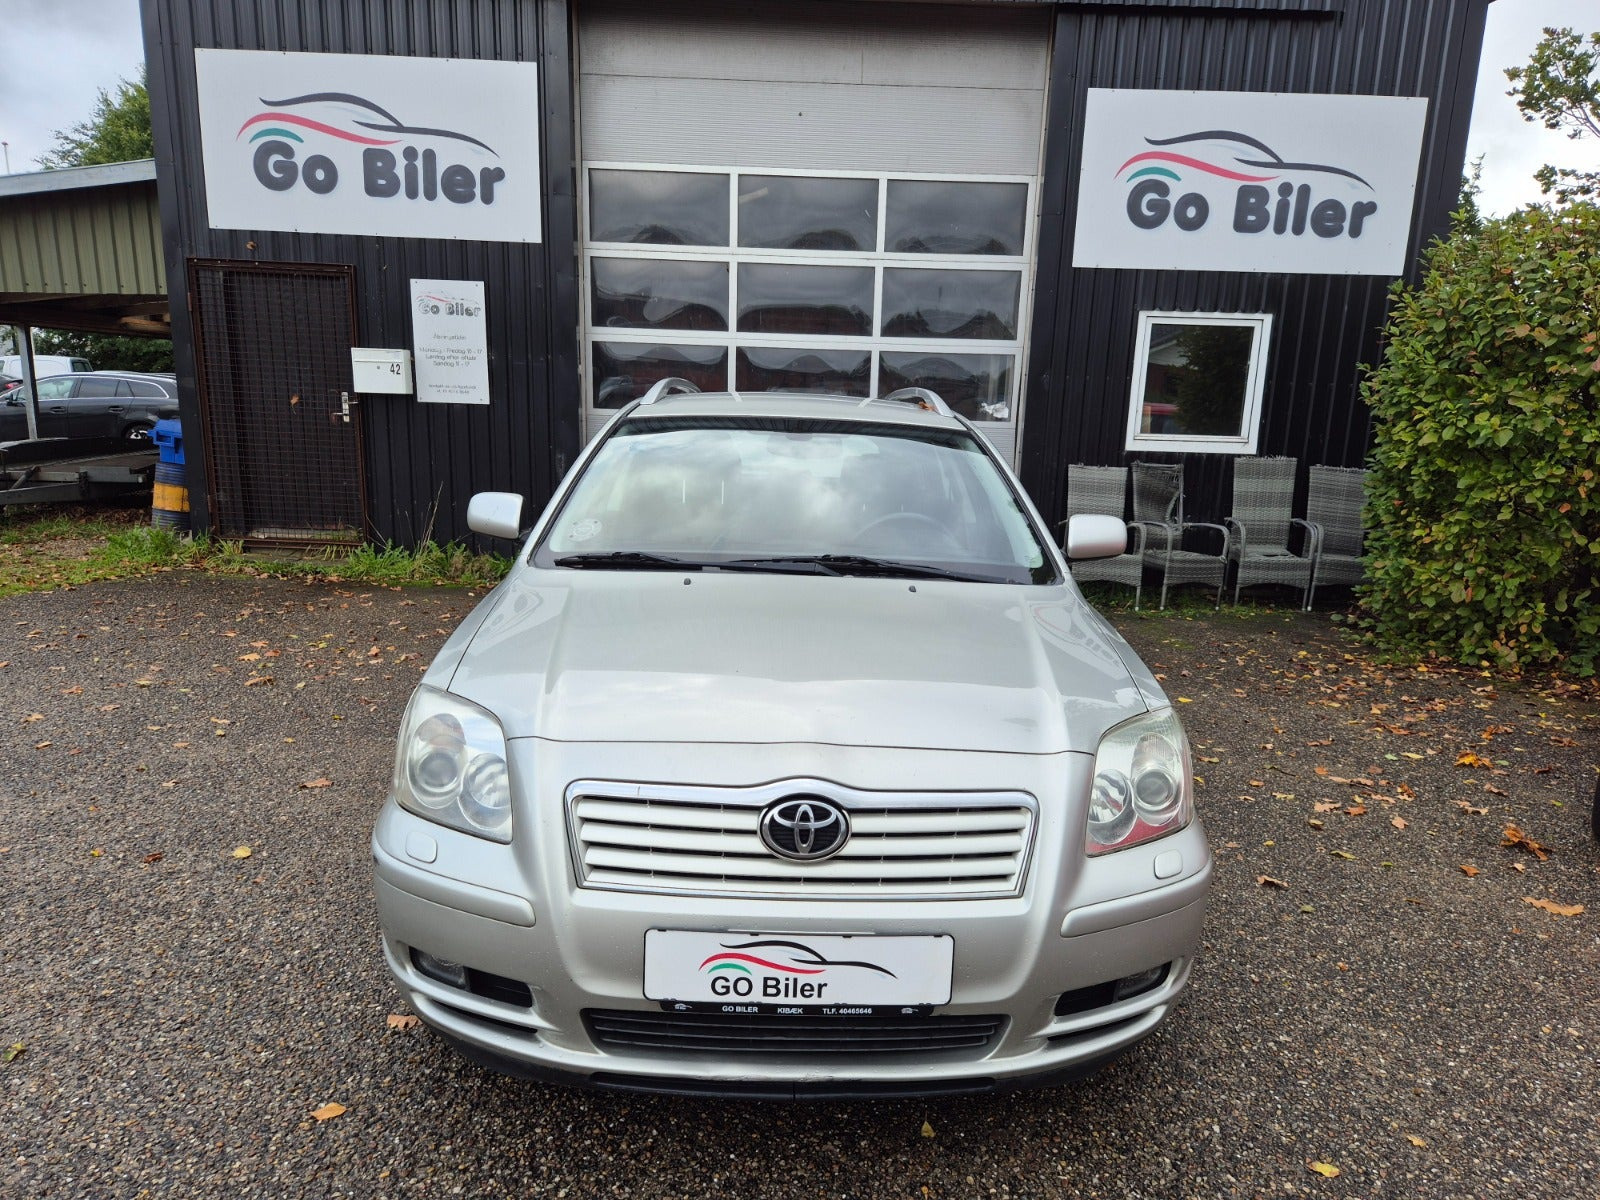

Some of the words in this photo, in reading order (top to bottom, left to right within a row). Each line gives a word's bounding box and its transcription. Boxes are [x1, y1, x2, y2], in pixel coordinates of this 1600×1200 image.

[253, 140, 338, 194] Go
[363, 146, 505, 205] Biler
[1127, 179, 1209, 231] Go
[1233, 182, 1377, 238] Biler
[419, 302, 440, 315] Go
[445, 303, 480, 317] Biler
[390, 363, 401, 375] 42
[710, 976, 753, 997] GO
[762, 976, 828, 999] Biler
